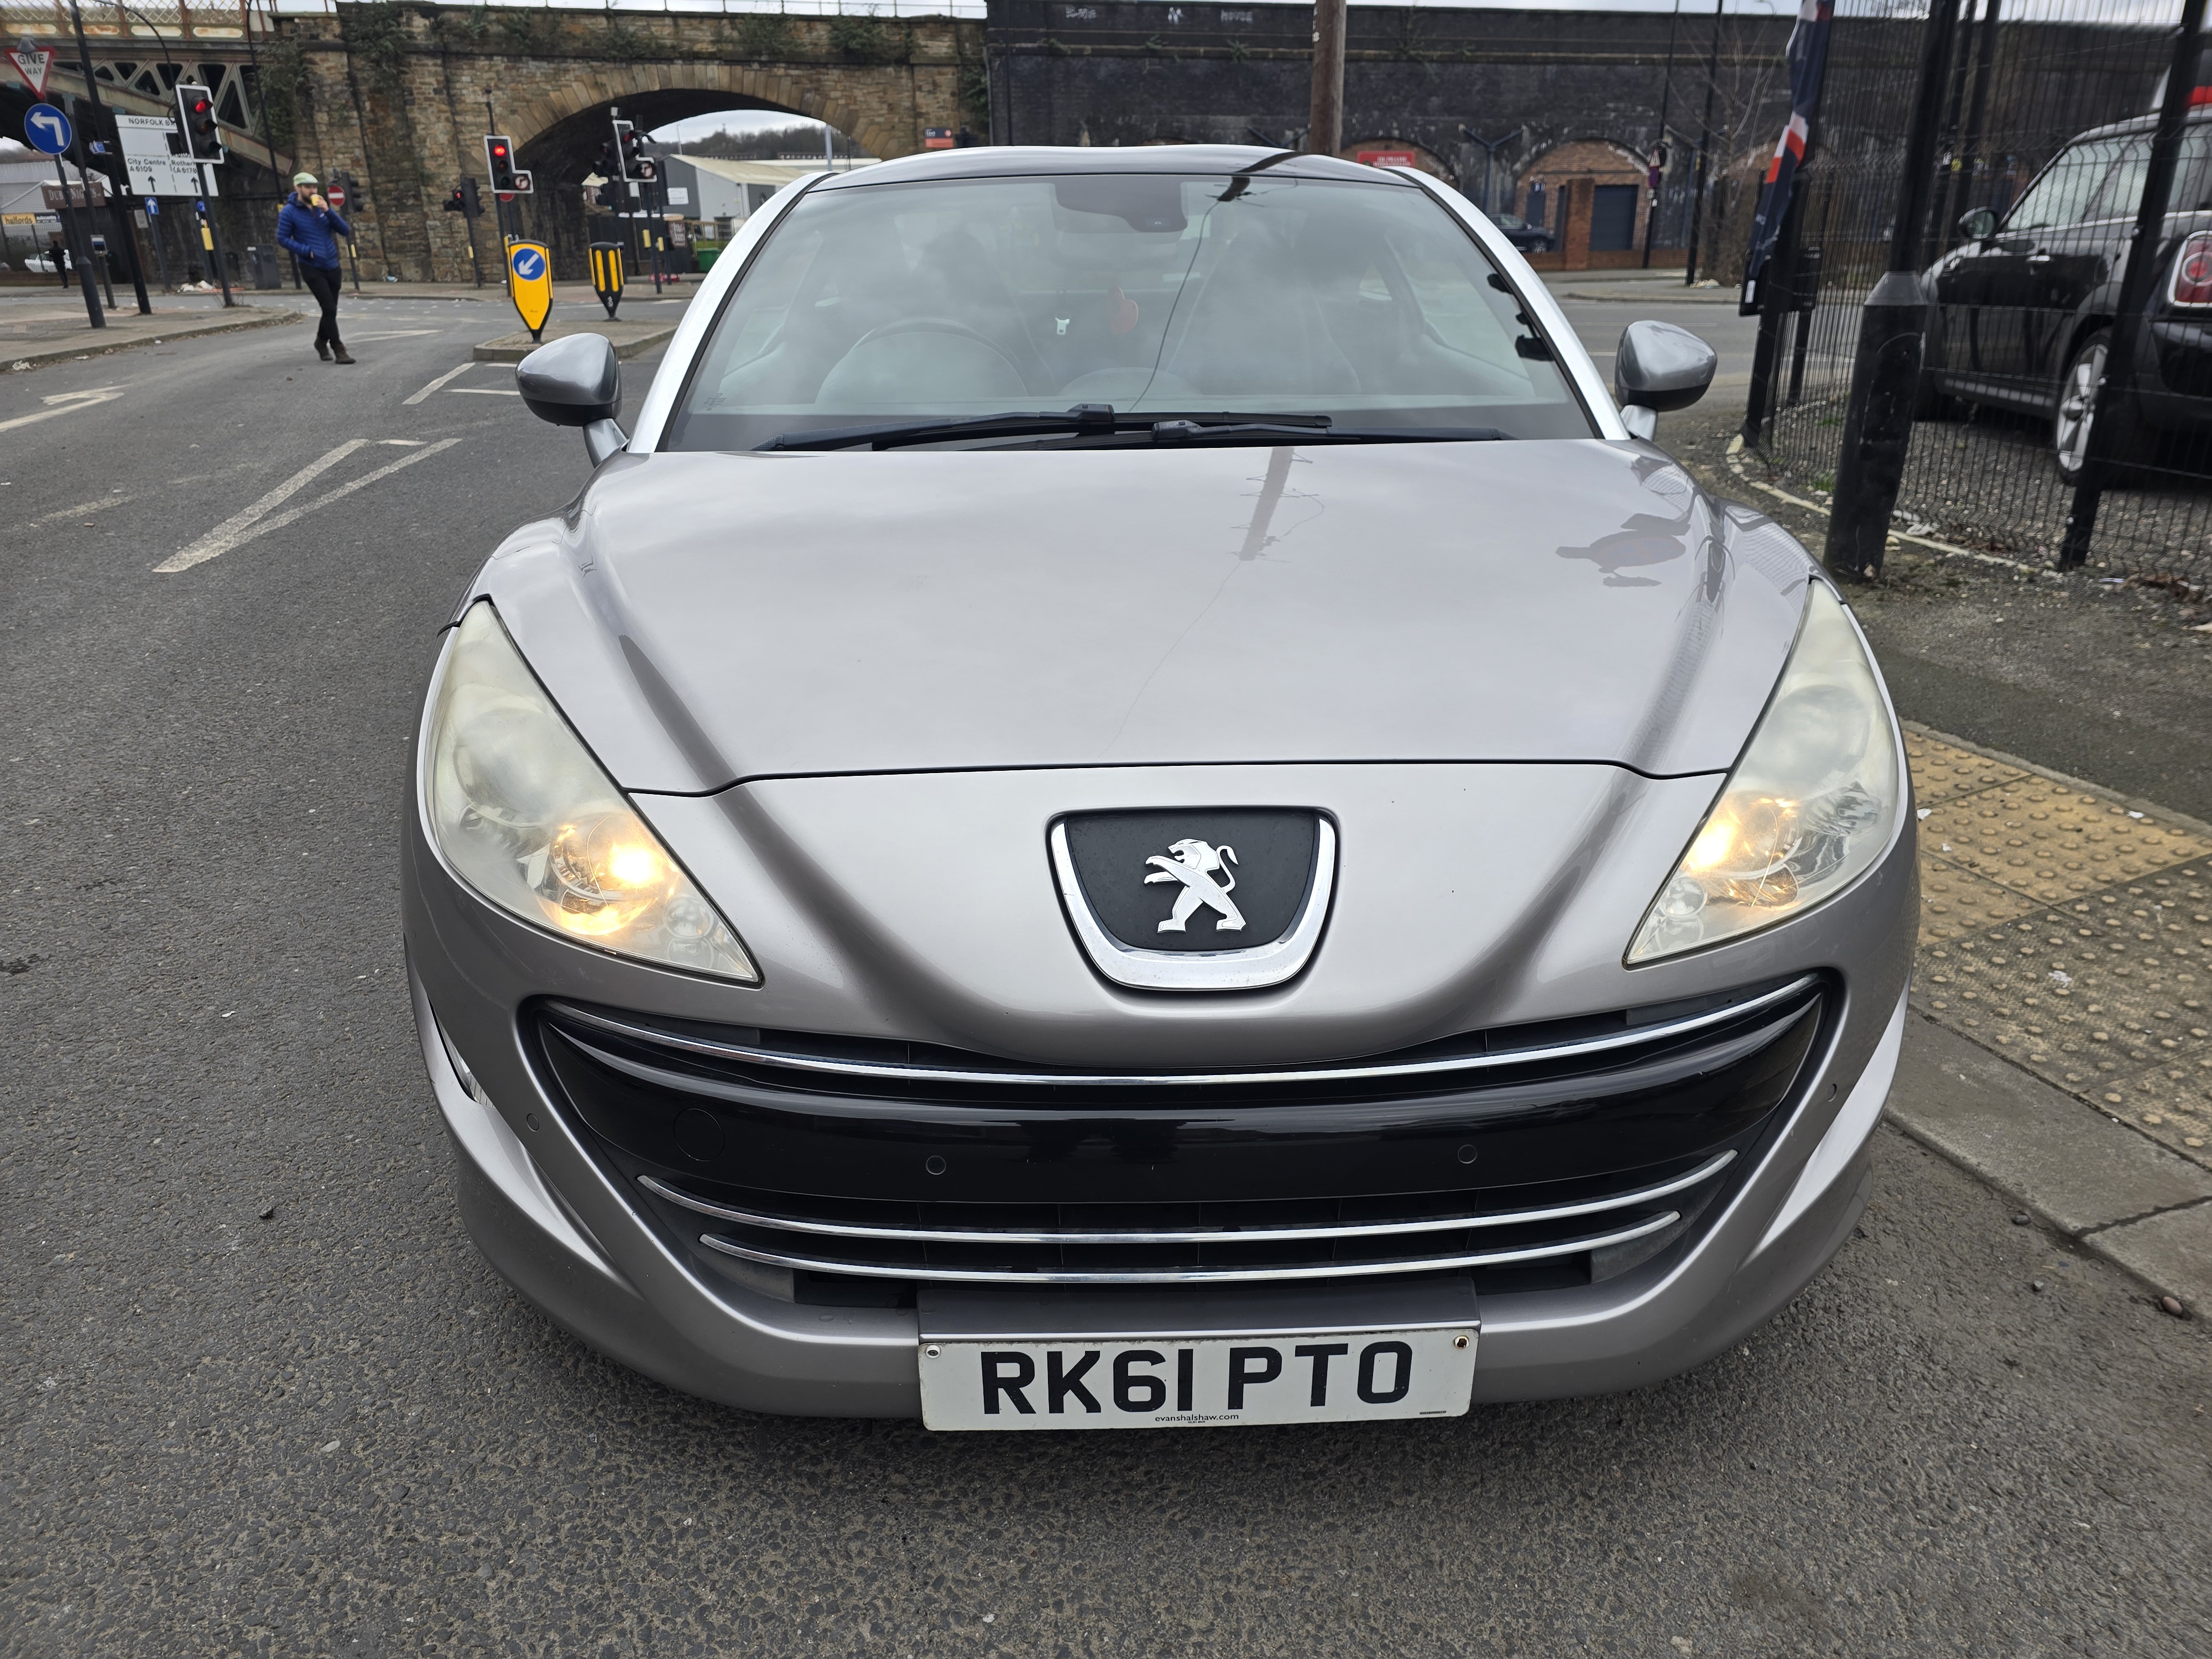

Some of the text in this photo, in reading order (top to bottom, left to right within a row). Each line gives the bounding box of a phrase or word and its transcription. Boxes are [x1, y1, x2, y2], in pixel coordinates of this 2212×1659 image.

[18, 54, 45, 64] GIVE
[5, 215, 33, 225] halfords
[981, 1341, 1412, 1415] RK61 PTO
